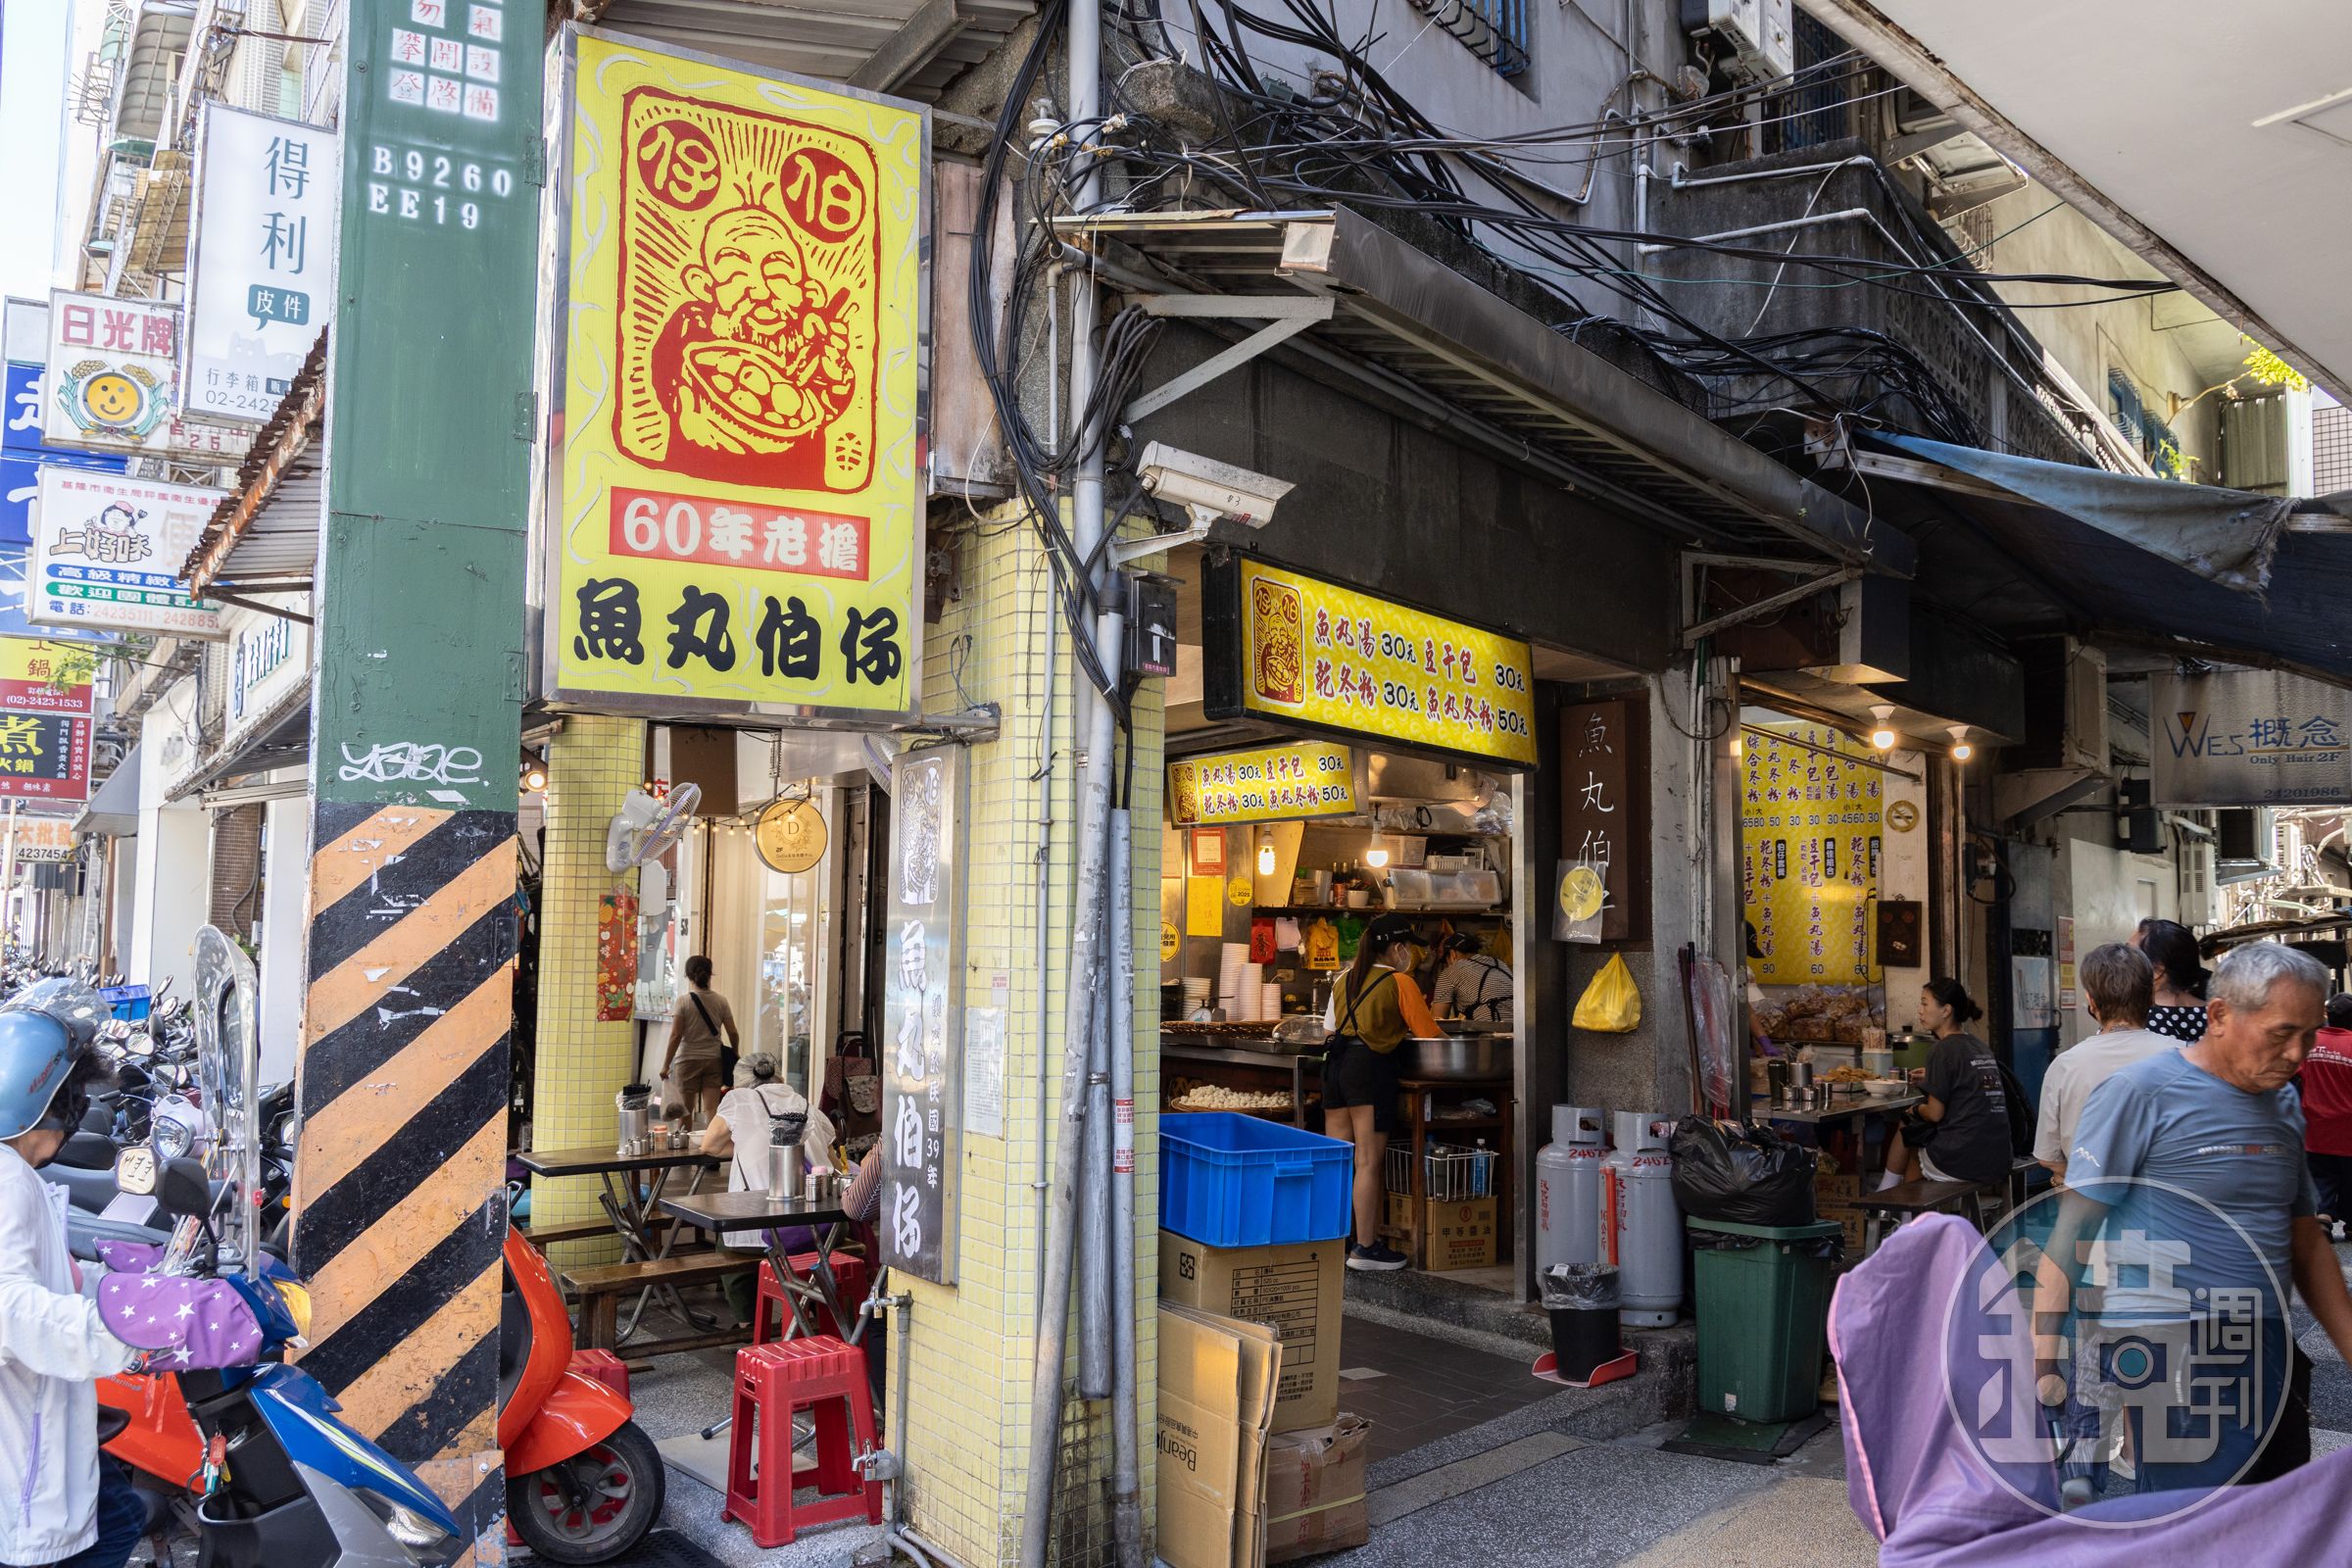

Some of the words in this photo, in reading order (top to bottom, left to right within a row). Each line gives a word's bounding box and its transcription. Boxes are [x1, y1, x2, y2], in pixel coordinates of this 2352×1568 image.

[260, 136, 311, 275] 得利
[255, 291, 303, 319] 皮件
[62, 304, 173, 355] 日光牌
[207, 368, 259, 392] 行李箱
[49, 526, 153, 564] 上好味
[1314, 609, 1376, 660] 魚丸湯
[1381, 633, 1417, 663] 30元
[1424, 639, 1477, 685] 豆干包
[1495, 663, 1526, 692] 30元
[6, 696, 83, 708] (02)-2423-1533
[1315, 660, 1378, 707] 乾冬粉
[1383, 682, 1419, 712] 30元
[1427, 686, 1495, 733] 魚丸冬粉
[1498, 709, 1528, 737] 50元
[2249, 715, 2340, 749] 概念
[1201, 763, 1236, 787] 魚丸湯
[1266, 756, 1304, 781] 豆干包
[2250, 755, 2278, 765] Only
[2286, 754, 2315, 763] Hair
[2317, 752, 2342, 763] 2F
[1578, 712, 1615, 909] 魚丸伯
[16, 848, 69, 859] 4237454
[1157, 1431, 1197, 1472] Beanj
